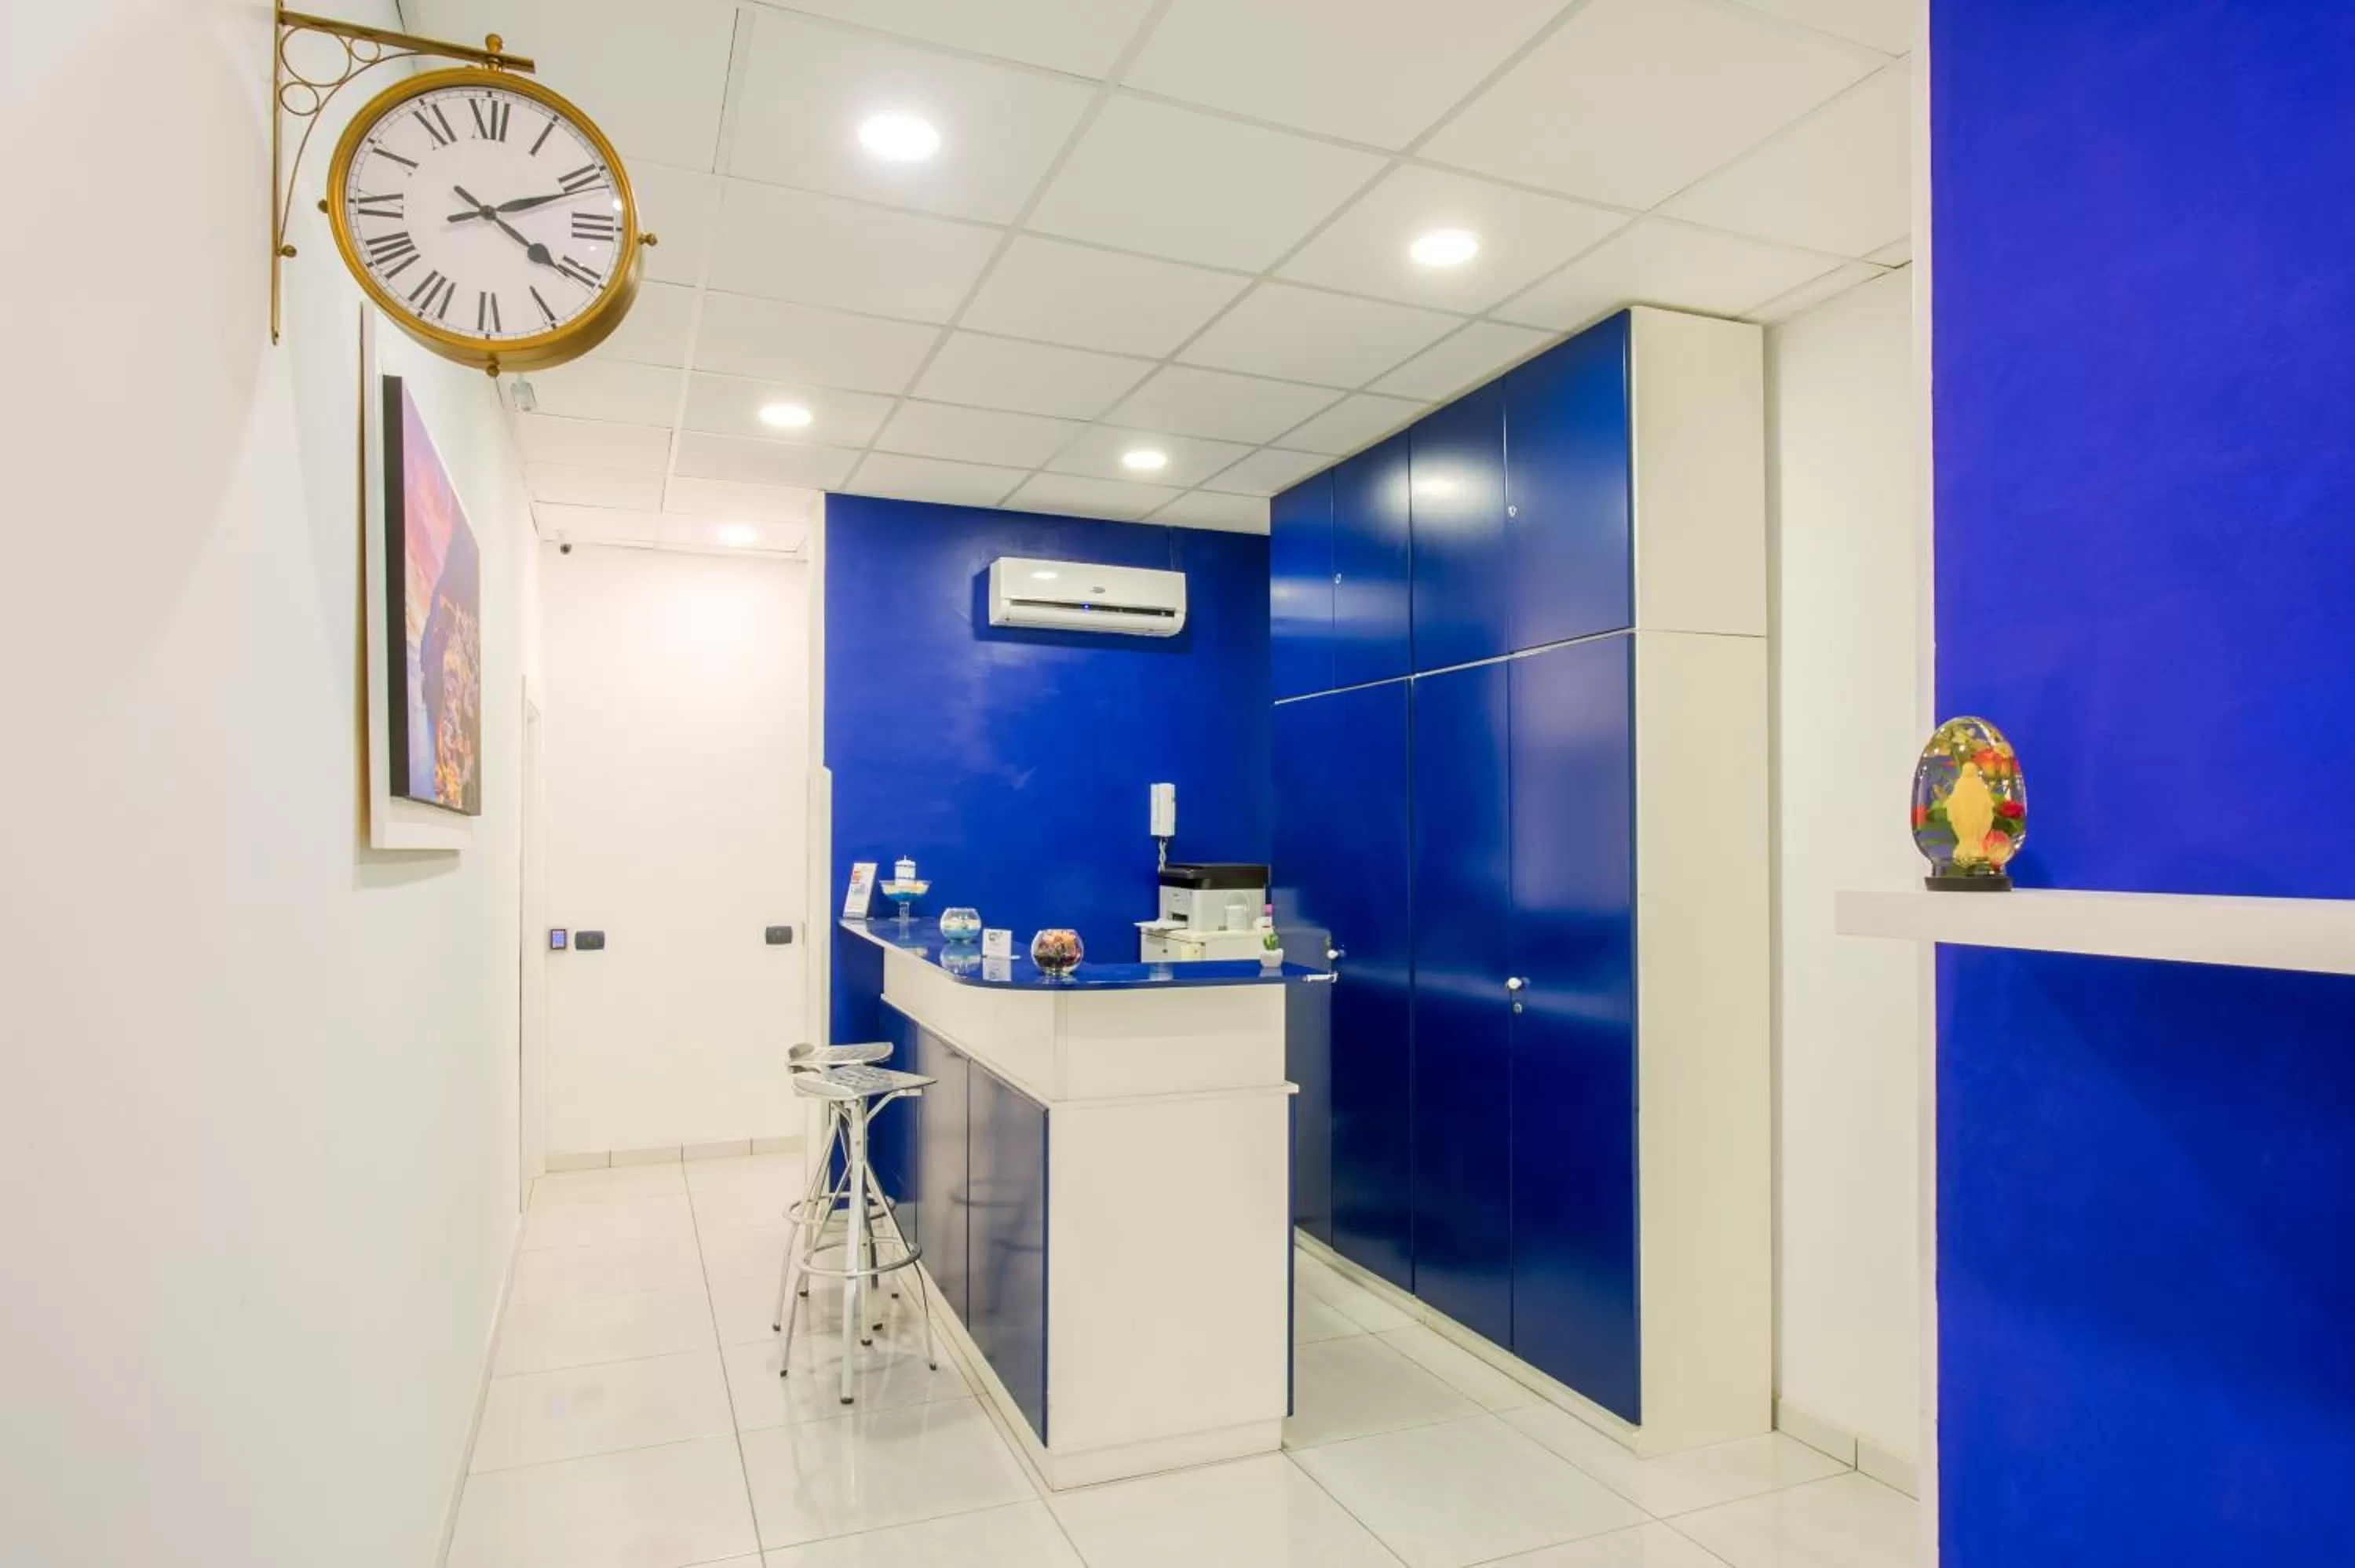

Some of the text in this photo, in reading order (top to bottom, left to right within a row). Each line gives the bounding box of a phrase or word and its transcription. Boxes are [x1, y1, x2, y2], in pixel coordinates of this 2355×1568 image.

[412, 103, 457, 151] XI
[468, 98, 511, 142] XII
[529, 122, 554, 157] I
[372, 140, 419, 177] X
[557, 163, 601, 192] II
[357, 188, 403, 221] IX
[571, 212, 615, 241] III
[365, 231, 421, 279] VIII
[407, 268, 457, 320] VII
[476, 290, 502, 333] VI
[528, 284, 557, 326] V
